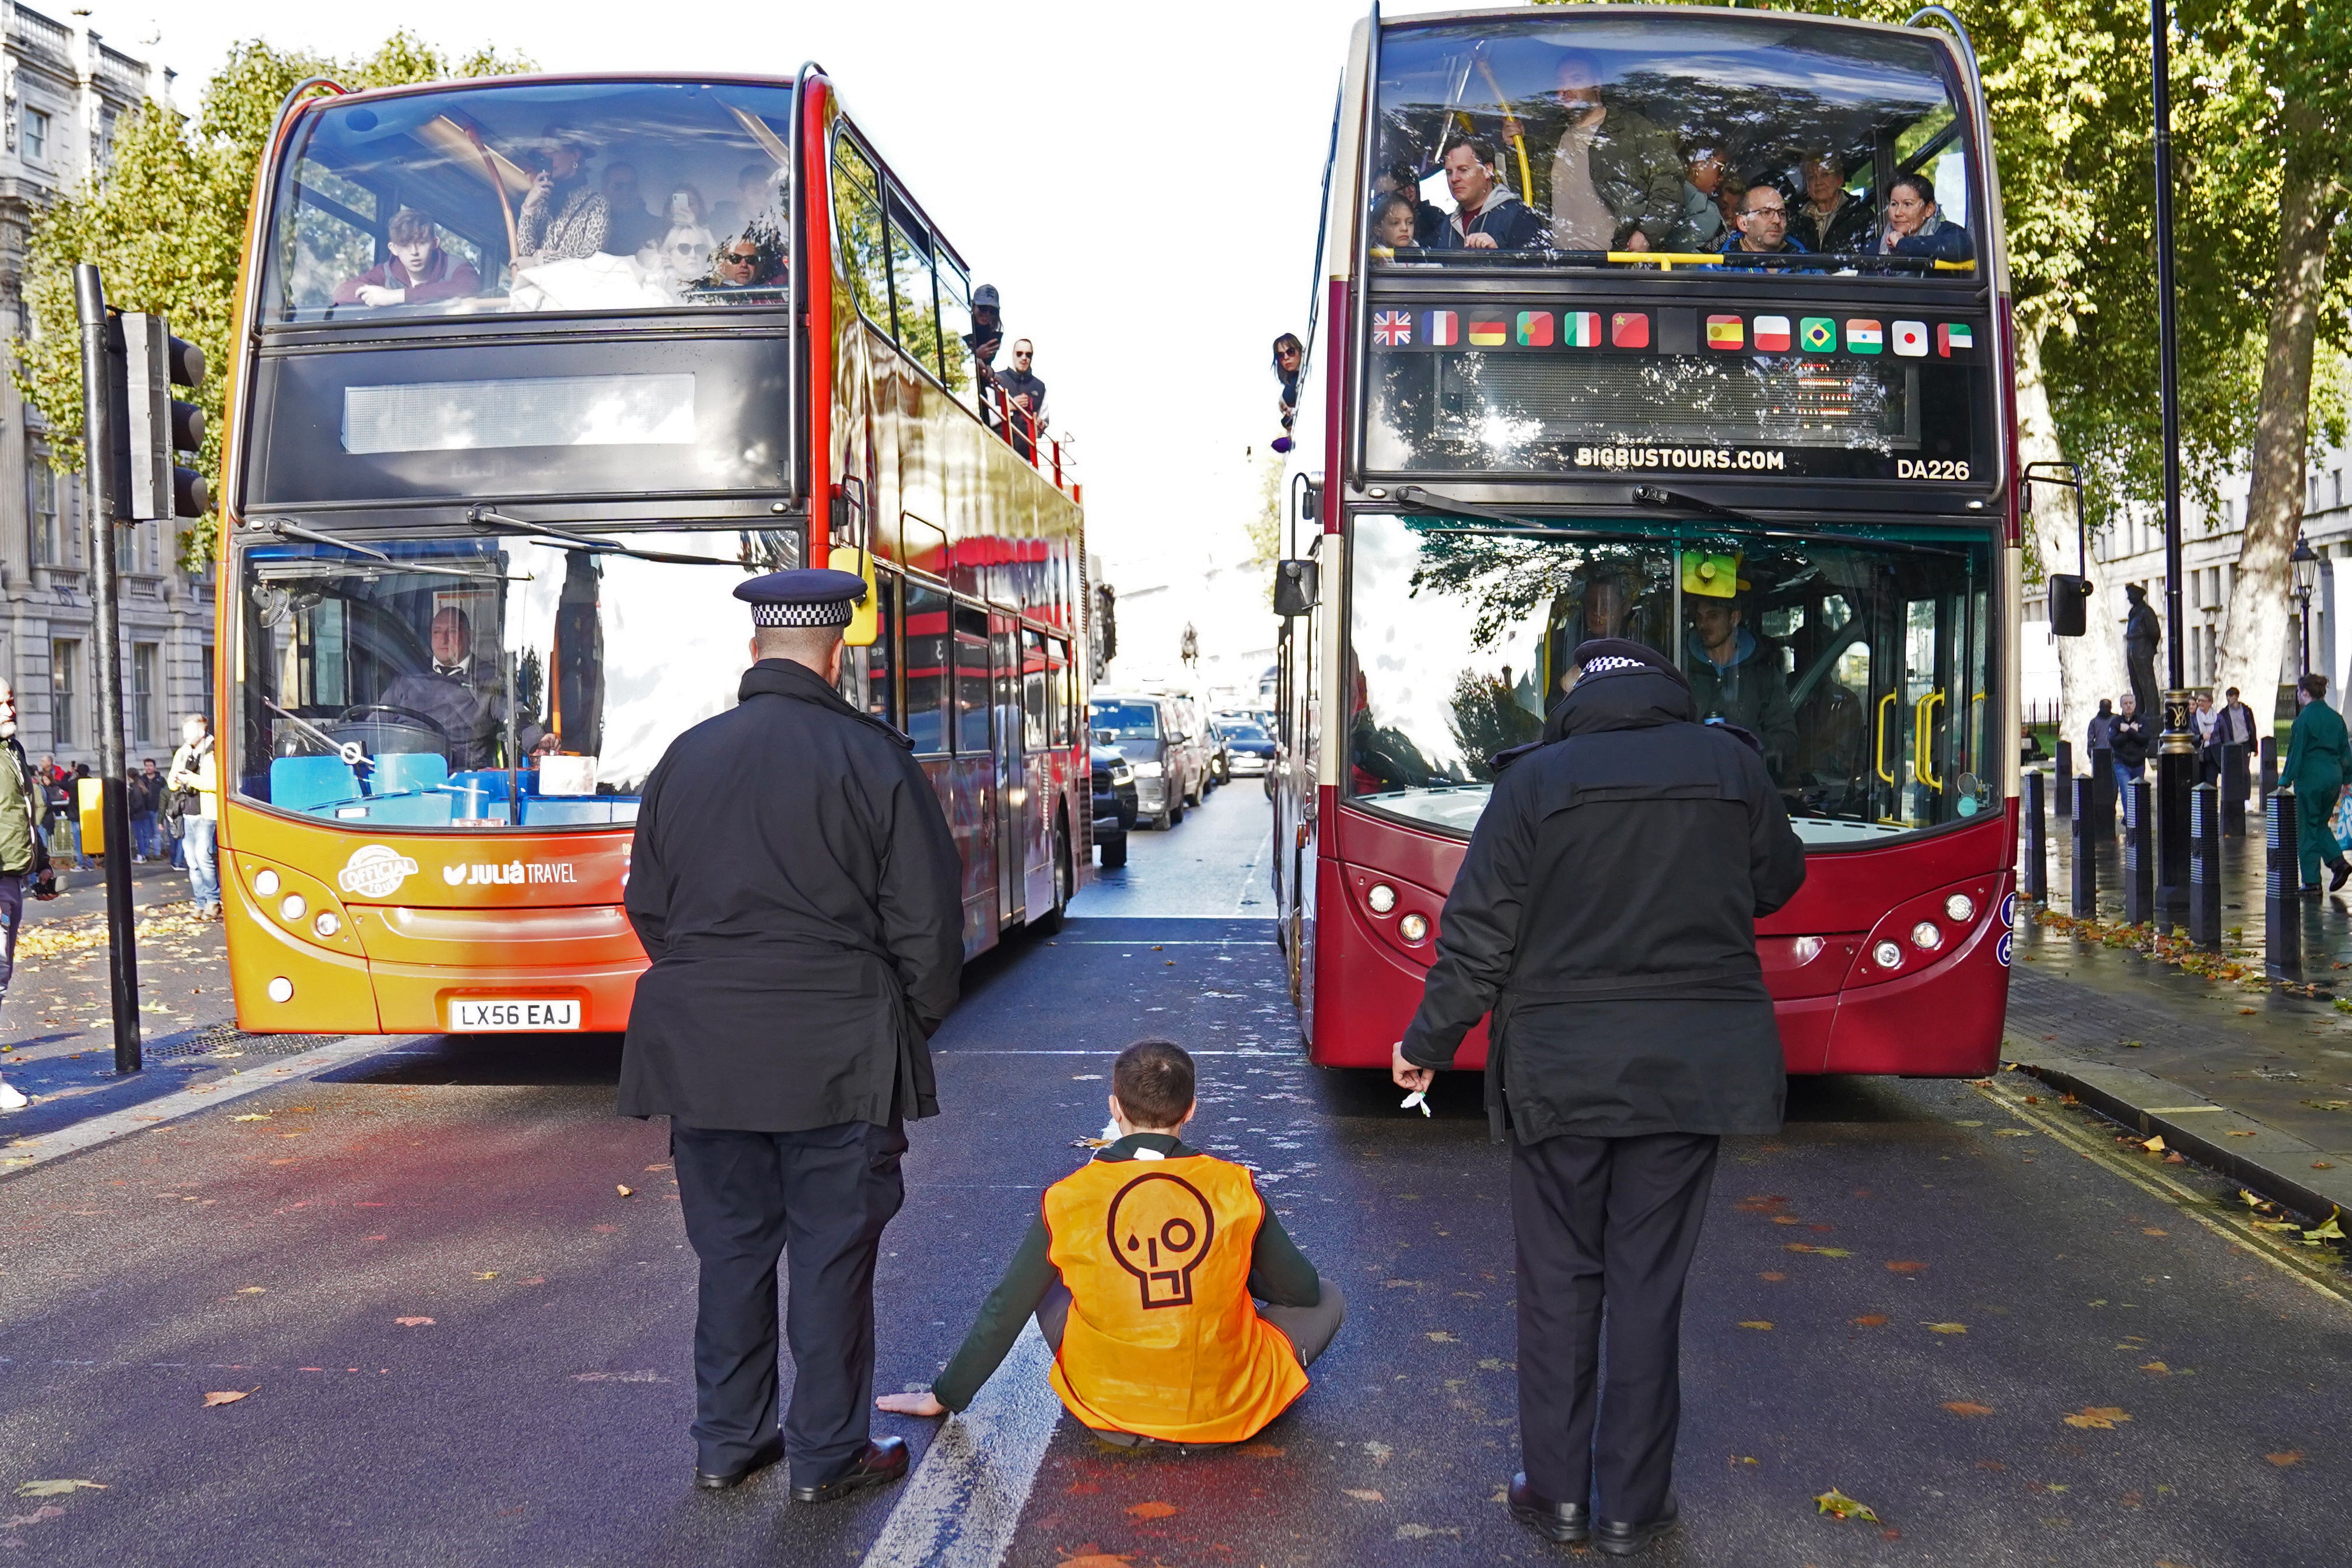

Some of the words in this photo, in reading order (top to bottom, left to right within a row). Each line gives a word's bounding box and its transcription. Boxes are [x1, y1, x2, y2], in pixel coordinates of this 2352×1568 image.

[1577, 447, 1784, 470] BIGBUSTOURS.COM
[1898, 459, 1970, 480] DA226
[346, 860, 412, 887] OFFICIAL
[526, 863, 578, 884] TRAVEL
[461, 1005, 520, 1025] LX56
[527, 1005, 570, 1024] EAJ
